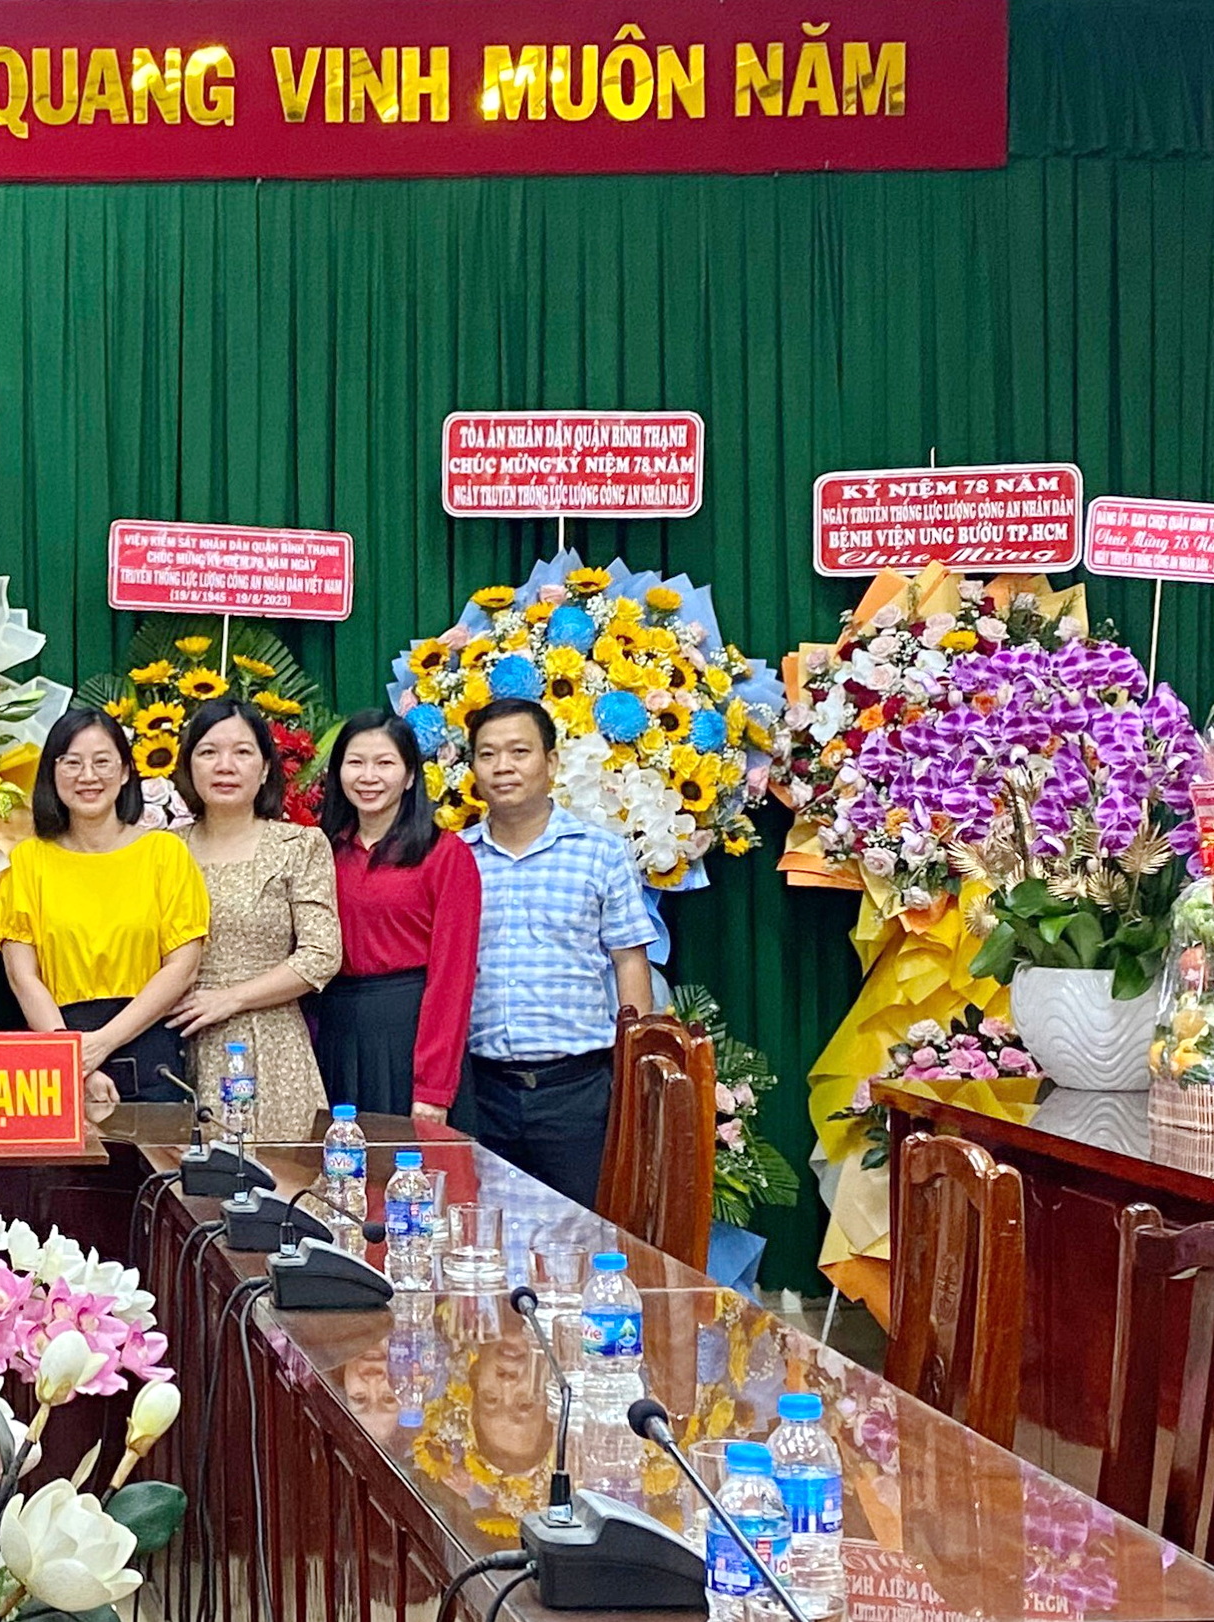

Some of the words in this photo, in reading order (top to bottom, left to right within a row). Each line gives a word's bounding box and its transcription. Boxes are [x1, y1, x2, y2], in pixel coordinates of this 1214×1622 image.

[272, 46, 450, 123] VINH
[482, 24, 705, 122] MUÔN
[735, 22, 906, 117] NĂM
[459, 420, 485, 448] TÒA
[487, 419, 506, 448] ÁN
[508, 420, 544, 448] NHÂN
[545, 419, 572, 448] DÂN
[574, 419, 609, 453] QUẬN
[611, 420, 642, 447] BÌNH
[644, 425, 687, 452] THẠNH
[450, 452, 496, 474] CHÚC
[500, 452, 552, 474] MỪNG
[556, 449, 581, 474] KỶ
[585, 451, 630, 477] NIỆM
[633, 457, 650, 474] 78
[654, 451, 694, 474] NĂM
[453, 479, 479, 506] NGÀY
[480, 474, 517, 506] TRUYỀN
[518, 475, 548, 506] THỐNG
[549, 477, 568, 509] LỰC
[569, 481, 599, 509] LƯỢNG
[600, 479, 625, 505] CÔNG
[626, 485, 640, 505] AN
[641, 478, 666, 505] NHÂN
[669, 478, 690, 505] DÂN
[842, 479, 881, 499] KỶ
[888, 478, 957, 499] NIỆM
[963, 479, 989, 495] 78
[995, 474, 1059, 493] NĂM
[822, 503, 849, 525] NGÀY
[850, 498, 888, 524] TRUYỀN
[890, 497, 923, 522] THỐNG
[923, 500, 943, 524] LỰC
[944, 499, 976, 523] LƯỢNG
[977, 497, 1004, 519] CÔNG
[1006, 501, 1021, 518] AN
[1022, 494, 1051, 518] NHÂN
[1052, 494, 1074, 517] DÂN
[125, 532, 148, 547] VIỆN
[150, 531, 176, 547] KIỂM
[178, 535, 197, 549] SÁT
[199, 537, 227, 550] NHÂN
[229, 538, 250, 551] DÂN
[251, 538, 278, 554] QUẬN
[281, 541, 304, 554] BÌNH
[307, 544, 339, 557] THẠNH
[829, 526, 873, 552] BỆNH
[876, 524, 916, 551] VIỆN
[958, 521, 1004, 544] BƯỚU
[1006, 523, 1068, 542] TP.HCM
[1173, 535, 1189, 551] 78
[146, 549, 174, 564] CHÚC
[176, 550, 206, 567] MỪNG
[266, 556, 288, 570] NĂM
[291, 556, 317, 571] NGÀY
[838, 551, 930, 566] Chúc
[939, 546, 1056, 563] Mừng
[120, 563, 152, 584] TRUYỀN
[154, 566, 180, 586] THỐNG
[182, 570, 198, 589] LỰC
[199, 570, 225, 590] LƯỢNG
[227, 571, 249, 589] CÔNG
[250, 575, 262, 590] AN
[263, 573, 285, 591] NHÂN
[287, 573, 303, 592] DÂN
[305, 574, 323, 595] VIỆT
[324, 578, 342, 595] NAM
